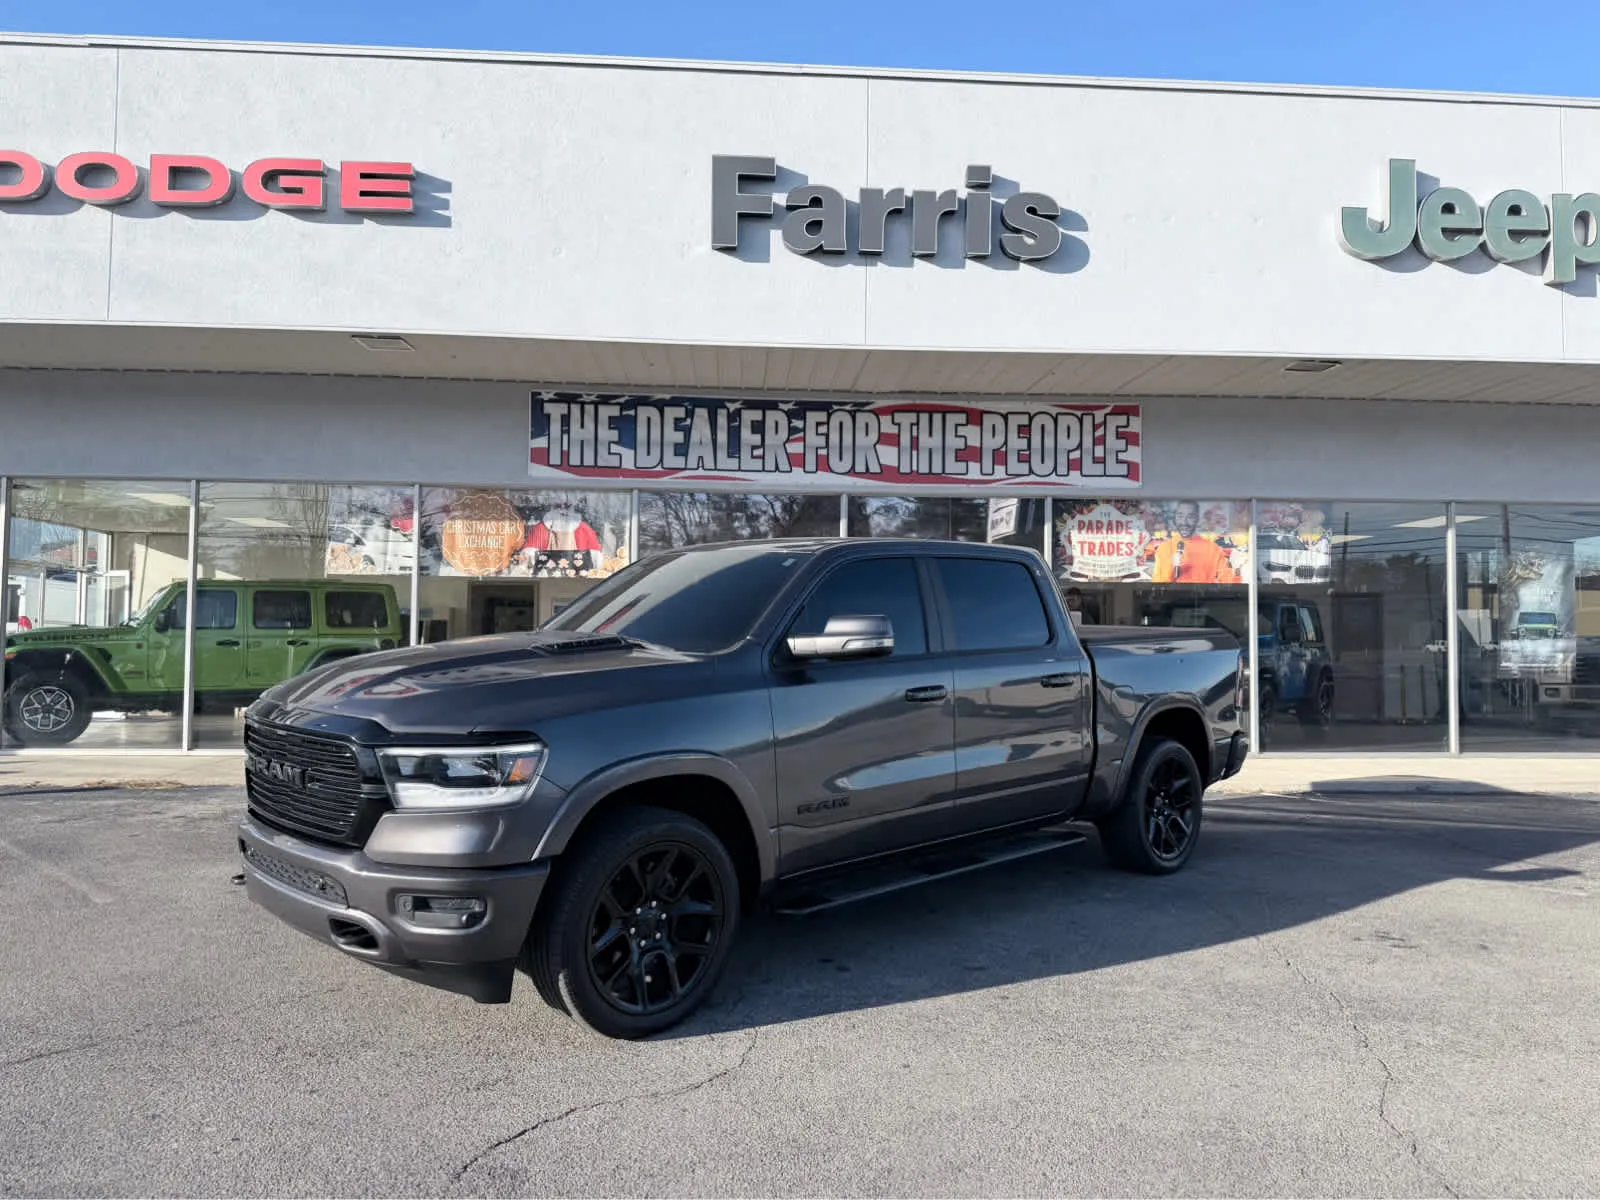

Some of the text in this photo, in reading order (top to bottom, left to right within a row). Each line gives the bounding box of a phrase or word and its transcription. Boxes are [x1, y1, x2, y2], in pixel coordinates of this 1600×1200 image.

[711, 154, 1063, 261] Farris
[544, 402, 1129, 477] THE DEALER FOR THE PEOPLE
[447, 520, 517, 534] CHRISTMAS CAR
[1077, 520, 1133, 536] PARADE
[1078, 541, 1134, 557] TRADES
